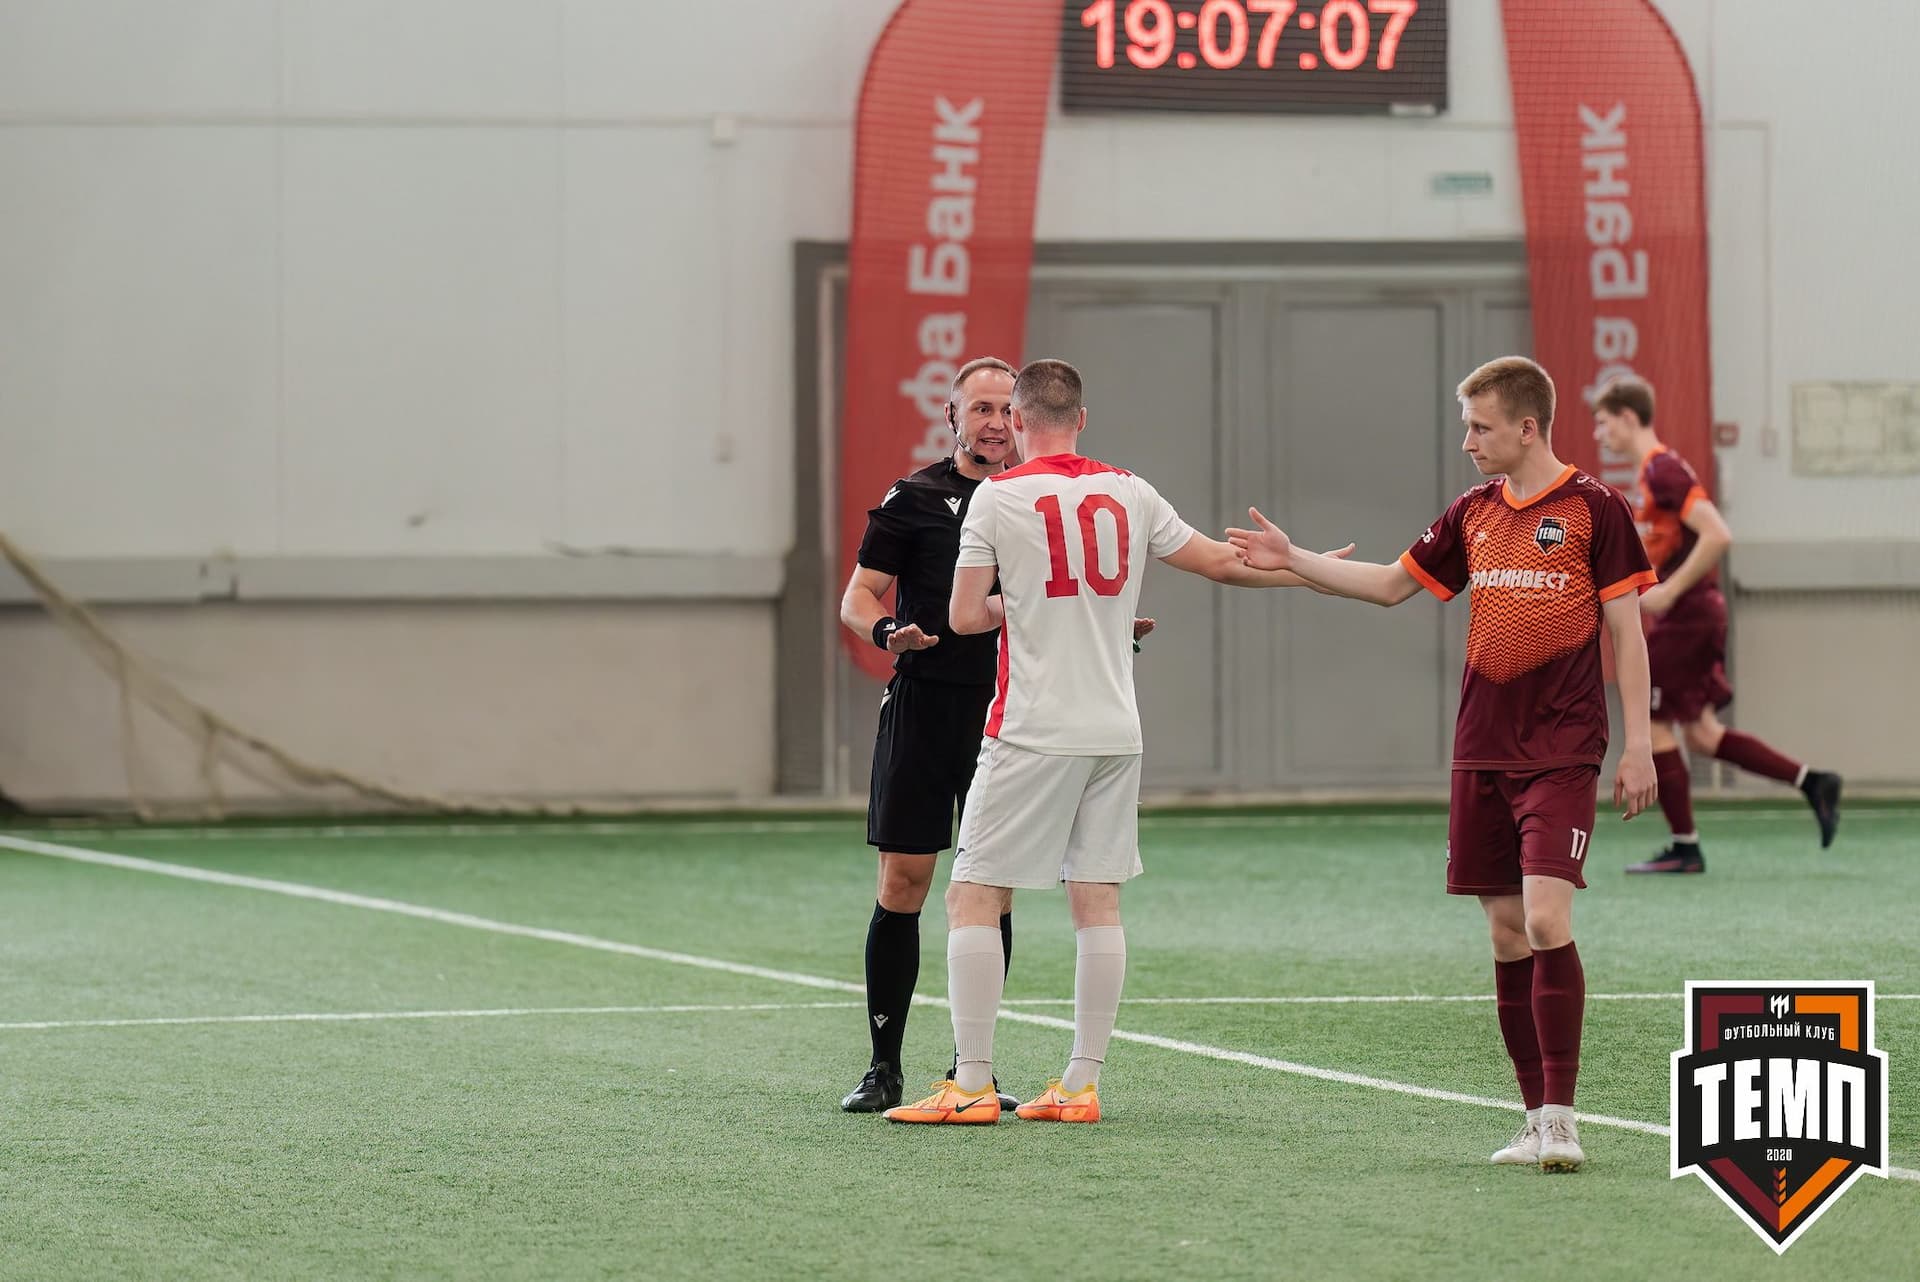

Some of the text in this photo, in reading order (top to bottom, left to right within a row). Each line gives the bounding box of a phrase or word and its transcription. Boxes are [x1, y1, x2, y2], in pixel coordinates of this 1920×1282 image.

[1081, 0, 1418, 70] 19:07:07
[907, 95, 985, 296] Банк
[1034, 494, 1130, 598] 10
[1538, 527, 1563, 542] ТЕМП
[1470, 568, 1570, 592] РОДИНВЕСТ
[1570, 828, 1587, 861] 17
